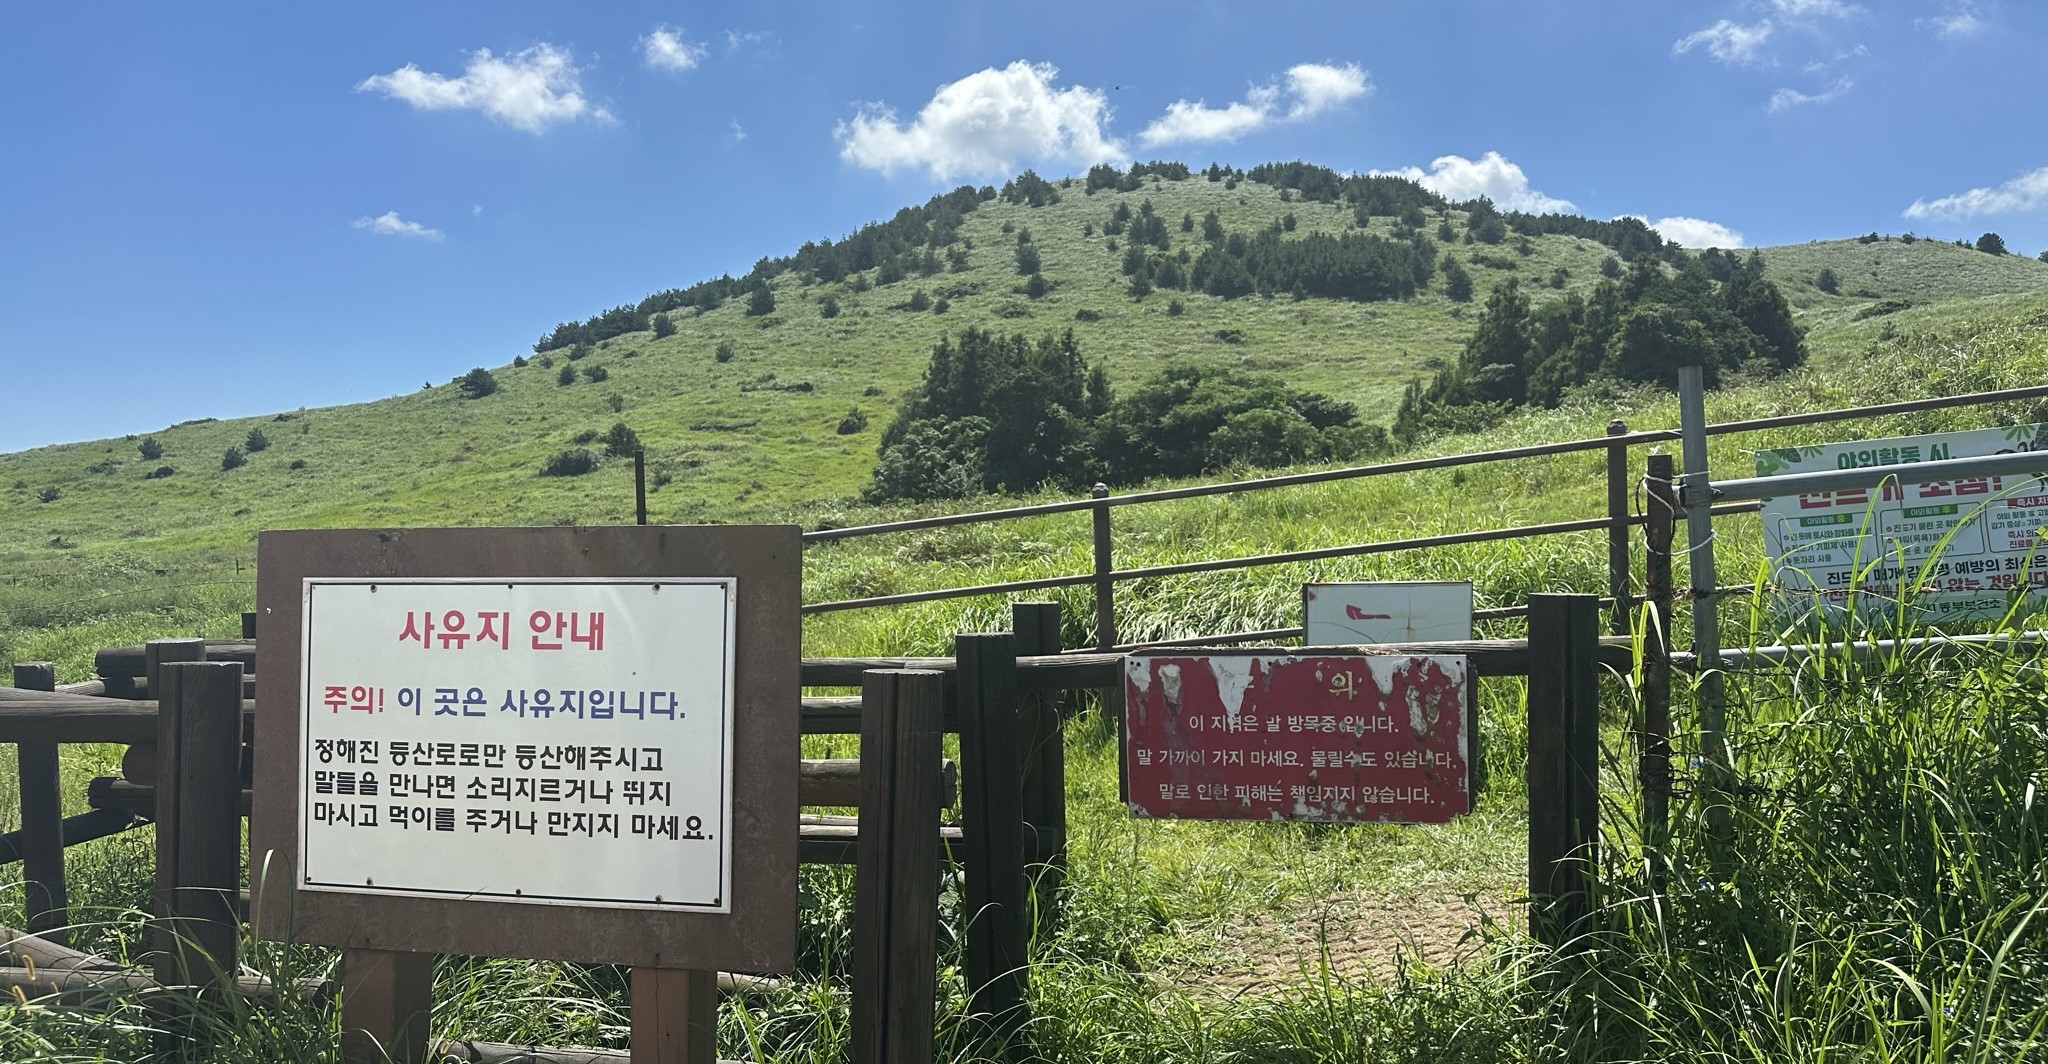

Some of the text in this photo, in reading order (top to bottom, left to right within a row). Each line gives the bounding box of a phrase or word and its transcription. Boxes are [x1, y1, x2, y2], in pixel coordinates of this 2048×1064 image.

[1837, 445, 1921, 470] 야외활동
[2016, 497, 2035, 507] 즉시
[1954, 558, 2000, 575] 예방의
[399, 609, 606, 651] 사유지 안내
[324, 685, 686, 720] 주의! 이 곳은 사유지입니다.
[1189, 714, 1205, 733] 이
[314, 738, 664, 772] 정해진 등산로로만 등산해주시고
[1137, 748, 1153, 766] 말
[1158, 748, 1206, 767] 가까이
[1212, 749, 1244, 767] 가지
[1250, 749, 1304, 768] 마세요.
[1384, 749, 1457, 769] 있습니다.
[314, 770, 672, 807] 말들을 만나면 소리지르거나 뛰지
[1158, 783, 1435, 804] 말로 인한 피해는 책임지지 않습니다.
[313, 802, 714, 841] 마시고 먹이를 주거나 만지지 마세요.
